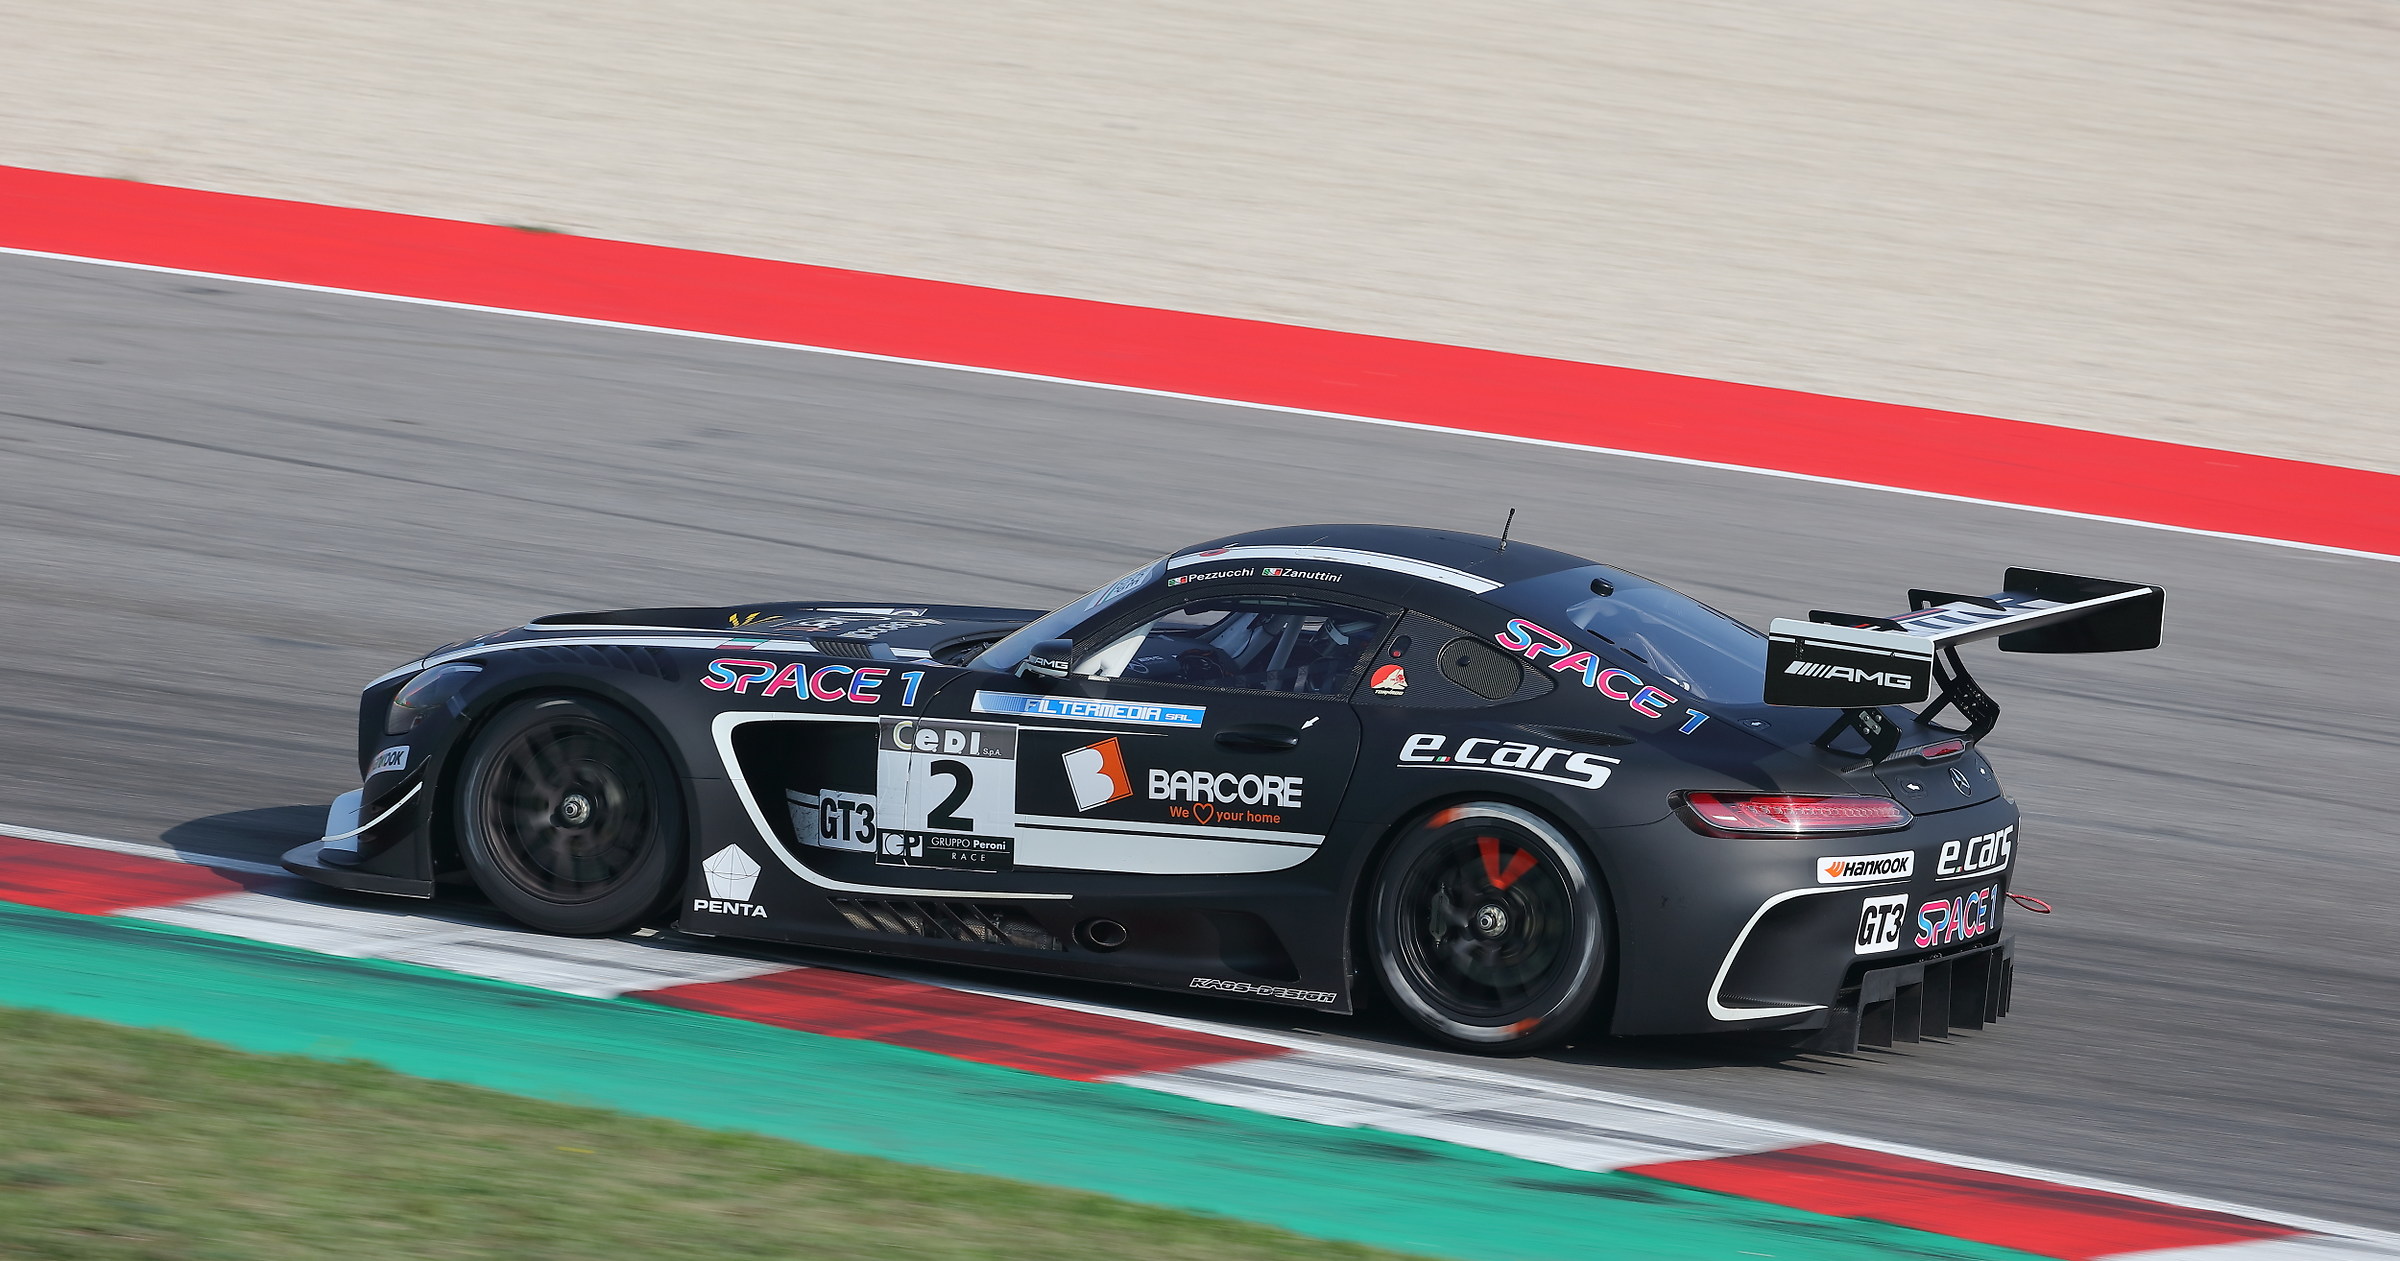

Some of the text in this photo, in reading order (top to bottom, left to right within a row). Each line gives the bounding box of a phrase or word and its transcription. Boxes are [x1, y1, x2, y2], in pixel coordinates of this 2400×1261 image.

[1188, 567, 1255, 583] Pezzucchi
[1281, 568, 1343, 583] Zanuttini
[1035, 656, 1069, 670] AMG
[1494, 618, 1711, 735] SPACE 1
[700, 658, 926, 707] SPACE 1
[1823, 665, 1912, 690] AMG
[1024, 698, 1193, 722] FILTERMEDIA SRL
[1398, 733, 1622, 790] e.cars
[926, 759, 974, 832] 2
[1148, 768, 1304, 808] BARCORE
[820, 797, 876, 844] GT3
[1169, 805, 1281, 824] We your home
[931, 836, 1007, 850] GRUPPO Peroni
[1937, 825, 2014, 876] e.cars
[951, 852, 986, 862] RACE
[693, 898, 768, 919] PENTA
[1914, 884, 1999, 949] SPACE 1
[1858, 903, 1905, 946] GT3
[1188, 977, 1338, 1004] KAOS-DESIGN
